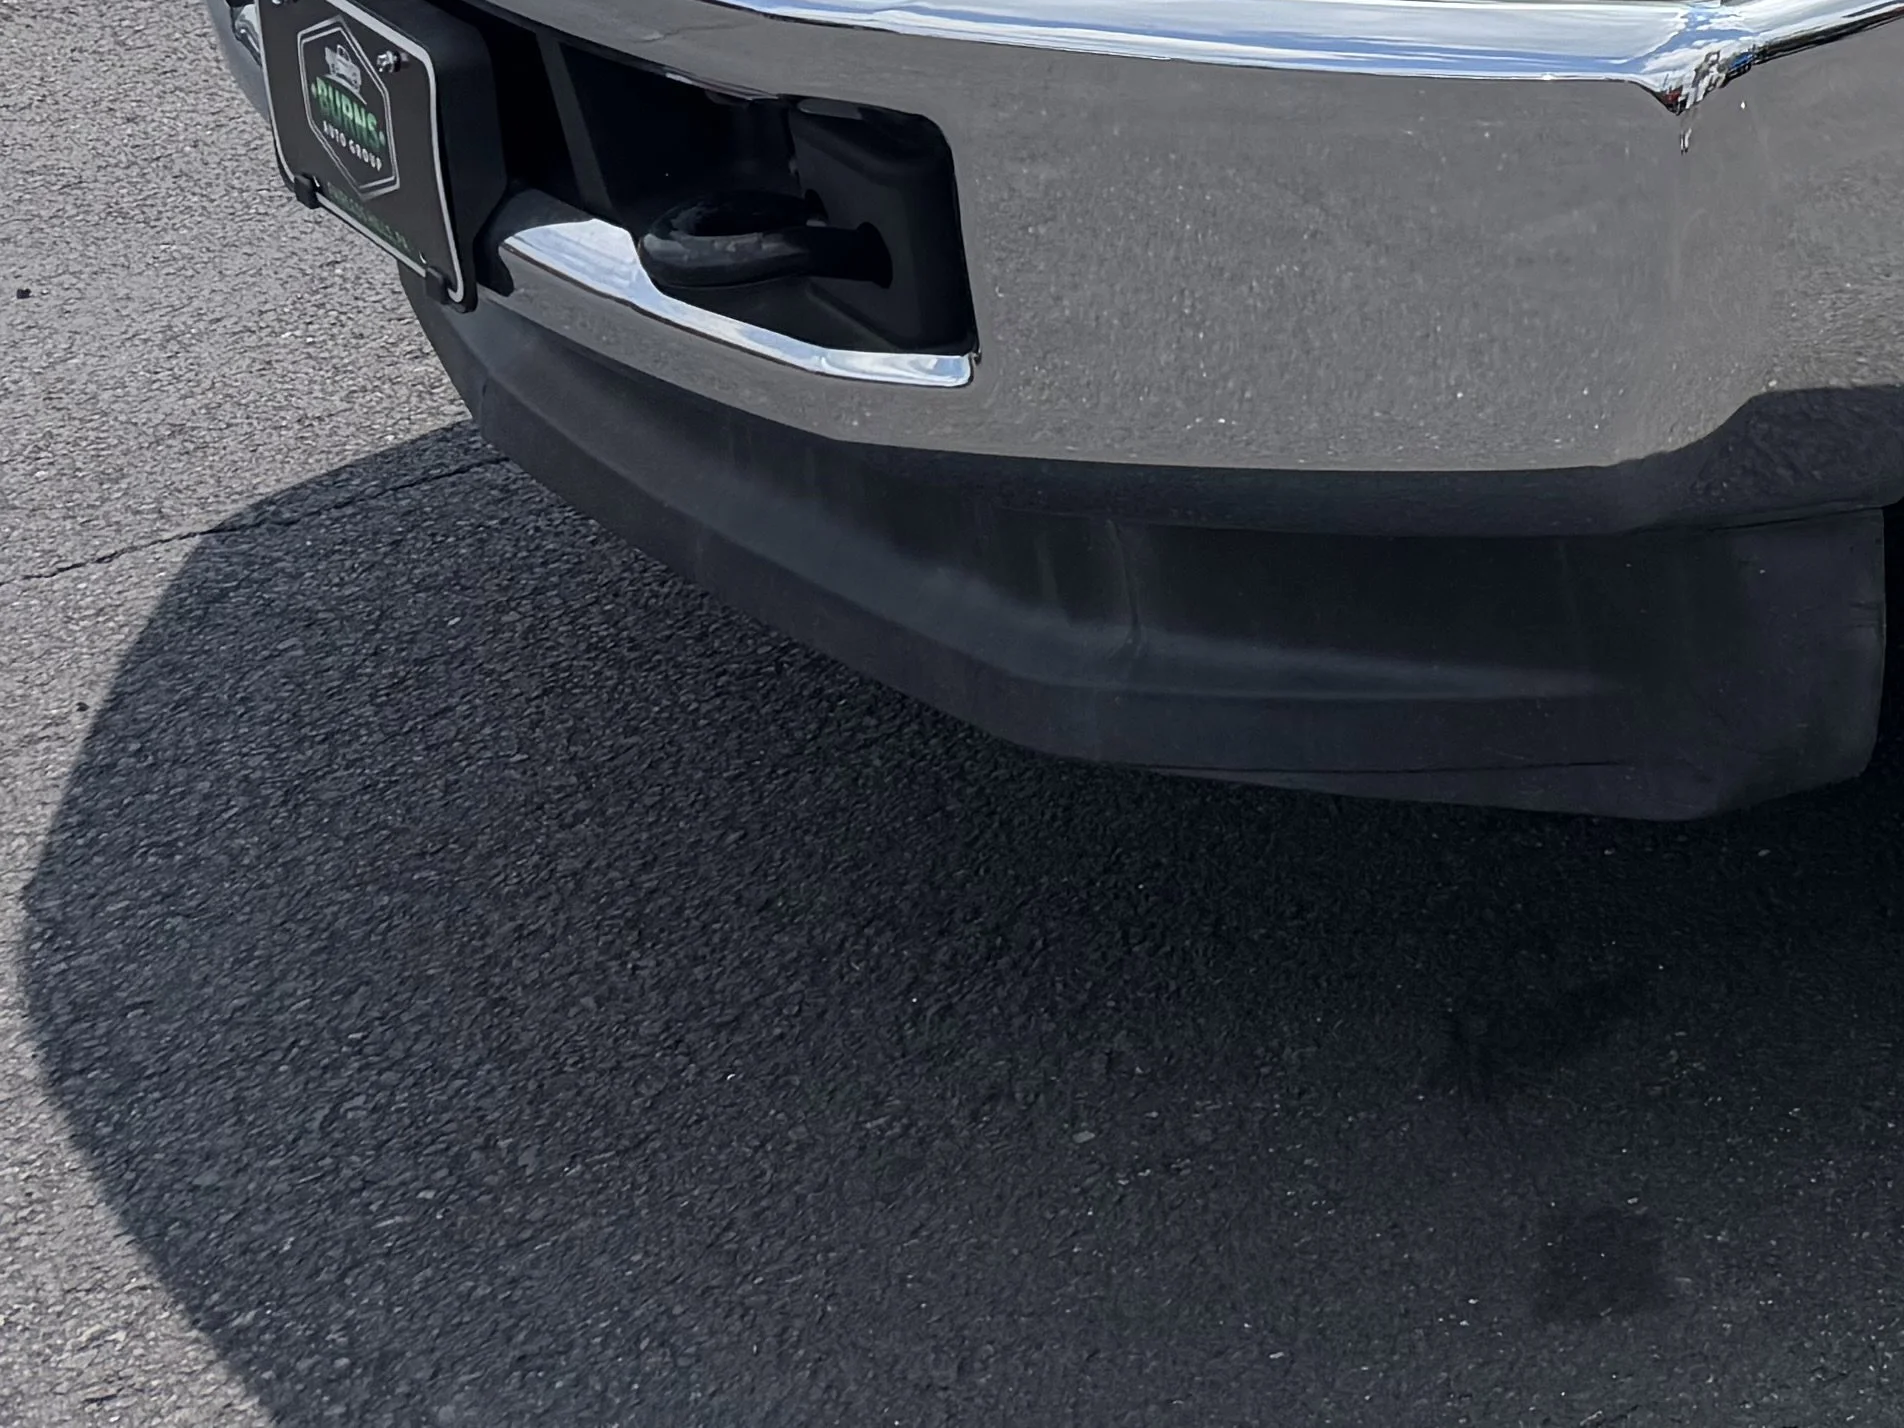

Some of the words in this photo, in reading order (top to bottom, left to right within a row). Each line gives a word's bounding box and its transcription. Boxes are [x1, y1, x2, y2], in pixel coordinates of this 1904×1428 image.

[315, 76, 382, 151] BURNS
[322, 119, 347, 149] AUTO
[348, 138, 384, 173] GROUP
